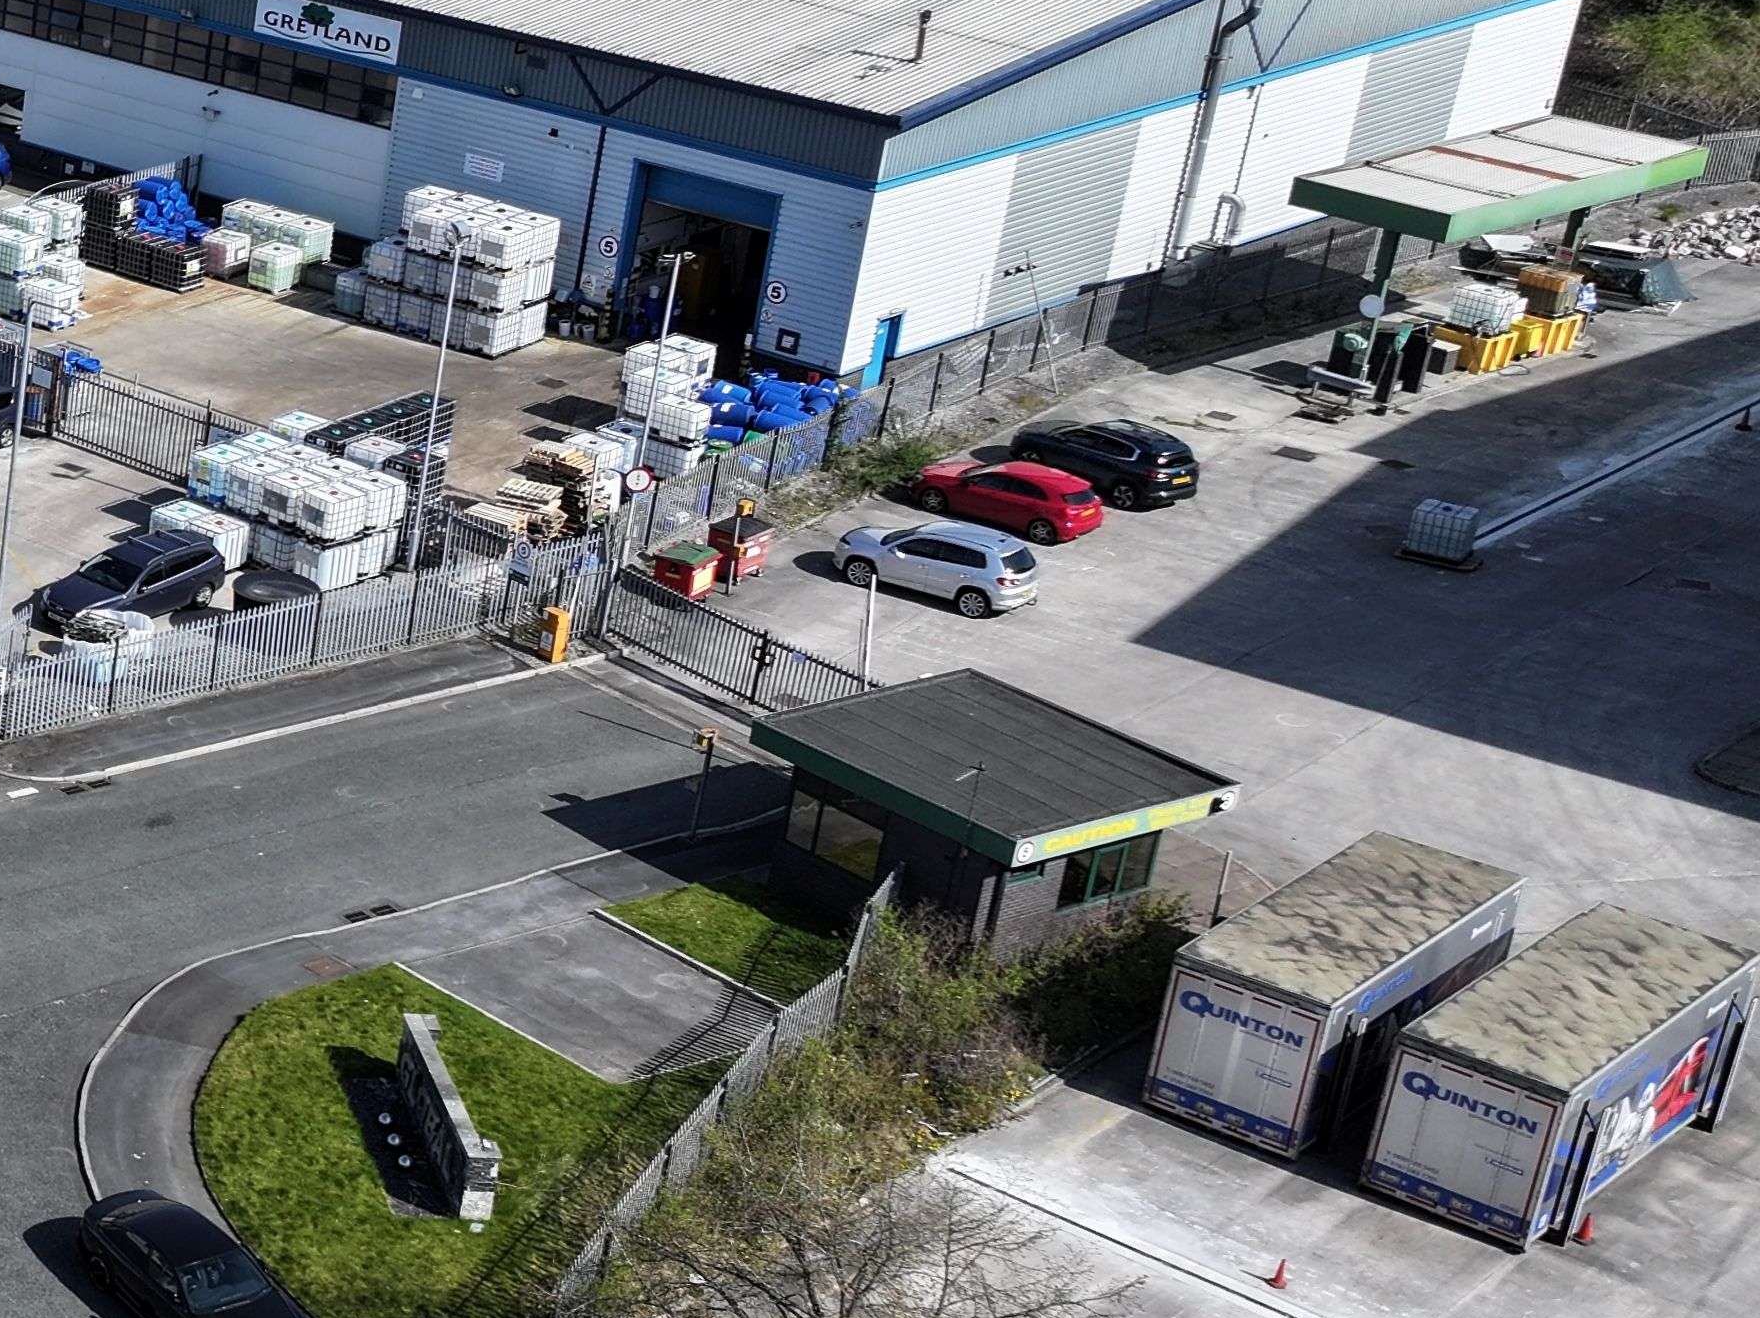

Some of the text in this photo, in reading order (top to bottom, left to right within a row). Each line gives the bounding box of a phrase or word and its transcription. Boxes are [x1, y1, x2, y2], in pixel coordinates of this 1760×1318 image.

[603, 241, 614, 253] 5
[771, 286, 782, 299] 5
[1180, 990, 1304, 1048] QUINTON
[1402, 1071, 1538, 1134] QUINTON
